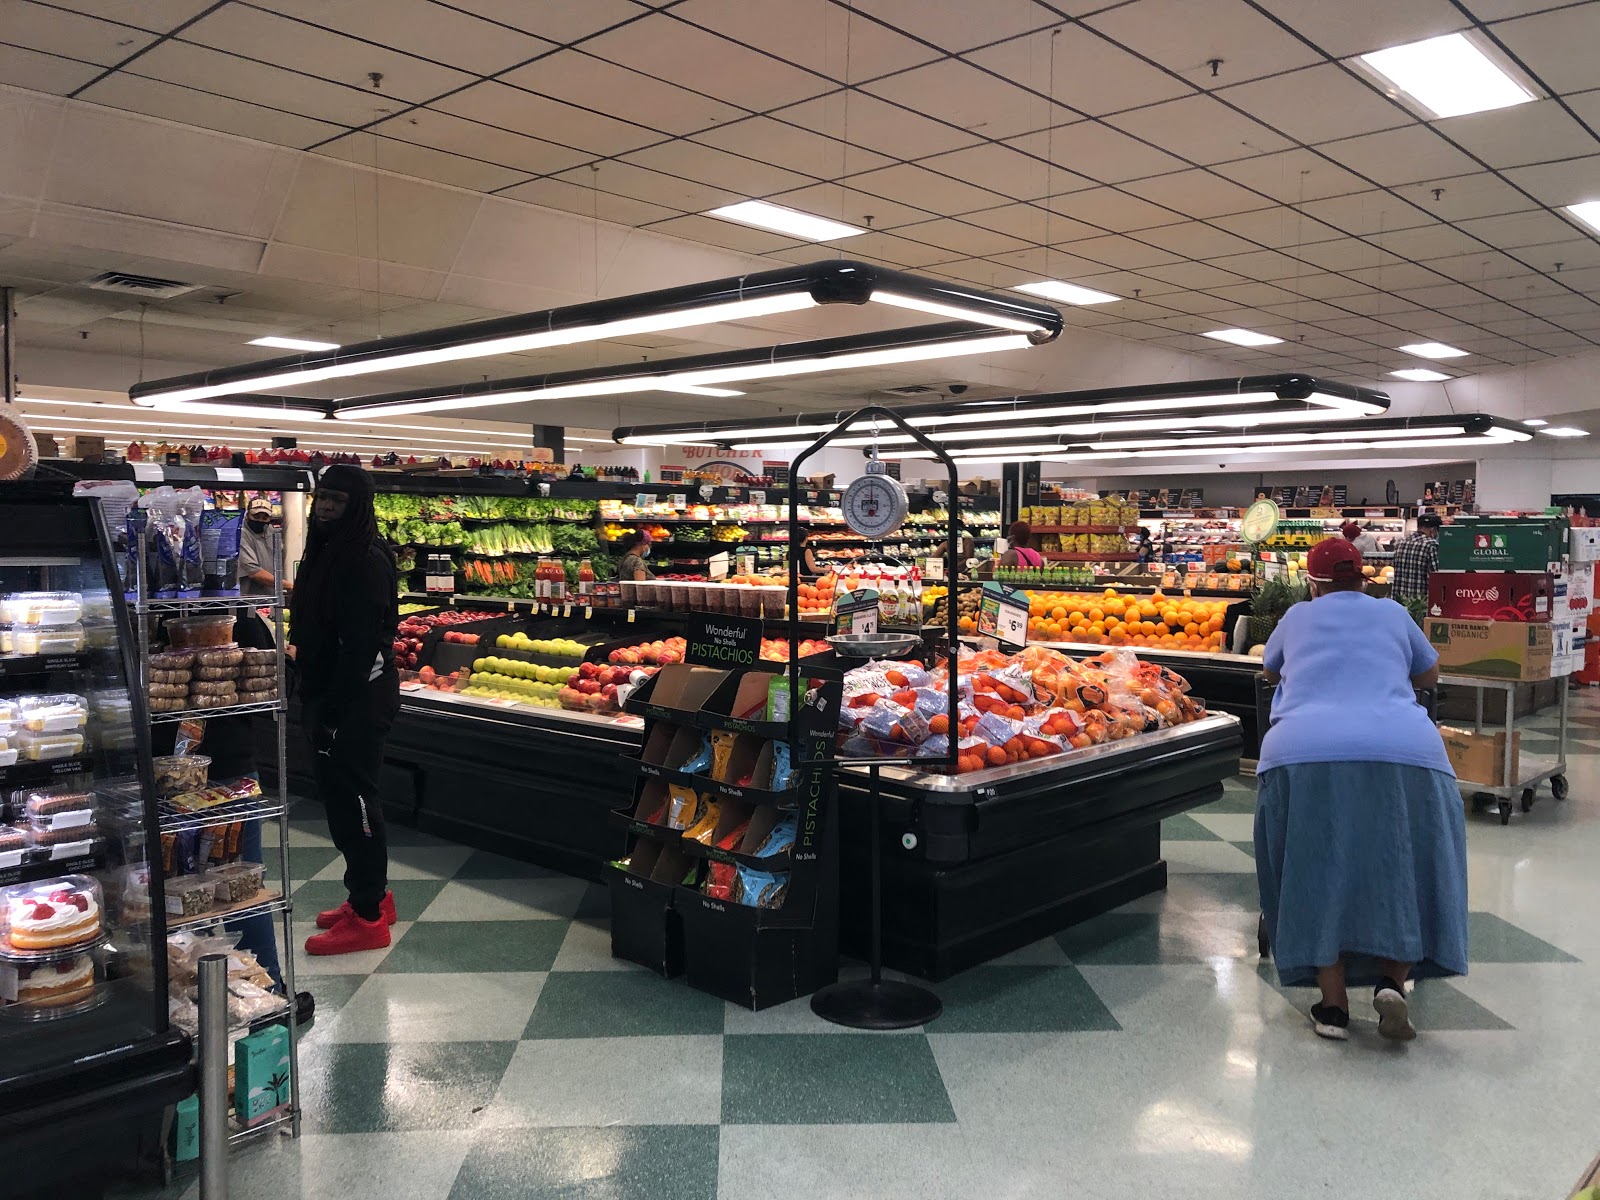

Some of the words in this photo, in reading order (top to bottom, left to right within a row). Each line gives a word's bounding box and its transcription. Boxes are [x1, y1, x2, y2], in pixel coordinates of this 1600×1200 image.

[683, 446, 763, 458] BUTCHER
[1456, 588, 1486, 604] envy
[705, 624, 747, 639] Wonderful
[1451, 630, 1489, 639] ORGANICS
[714, 637, 722, 645] No
[723, 638, 737, 647] Shells
[691, 642, 754, 664] PISTACHIOS
[724, 721, 756, 733] PISTACHIOS
[809, 729, 835, 738] Wonderful
[641, 766, 648, 774] No
[648, 767, 660, 776] Shells
[720, 786, 727, 794] No
[728, 788, 743, 797] Shells
[803, 740, 826, 846] PISTACHIOS
[625, 877, 632, 885] No
[632, 879, 643, 889] Shells
[702, 900, 710, 908] No
[711, 901, 725, 912] Shells
